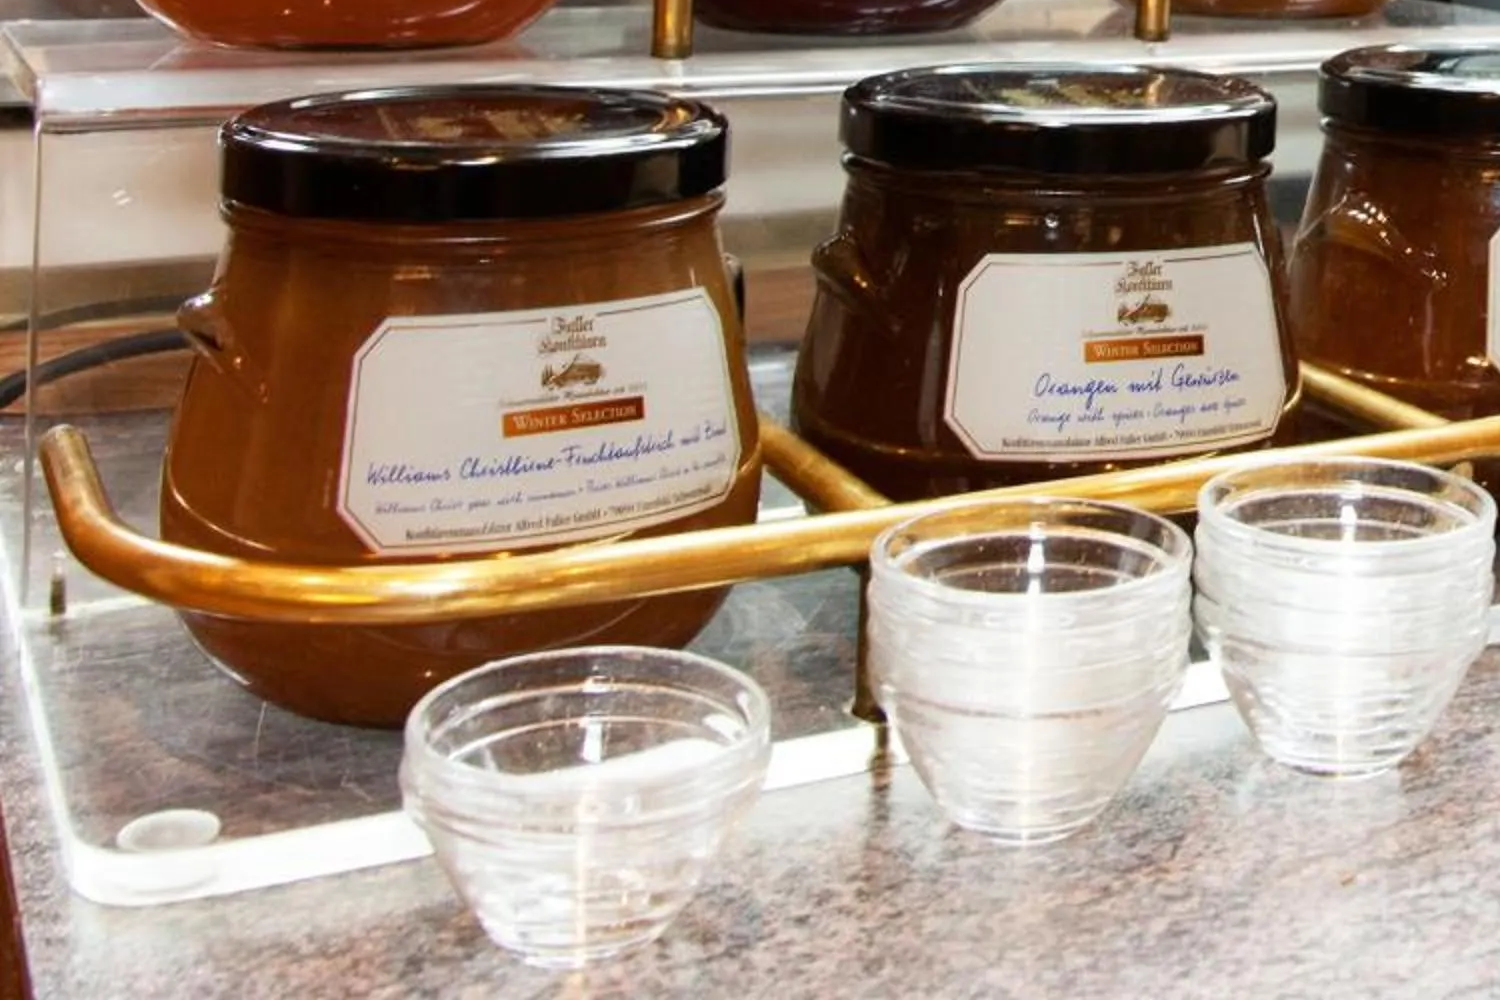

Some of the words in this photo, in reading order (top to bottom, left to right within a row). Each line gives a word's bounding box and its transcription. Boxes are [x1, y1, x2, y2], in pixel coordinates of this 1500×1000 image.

[1035, 372, 1118, 410] Orangen
[1127, 367, 1163, 393] mit
[513, 411, 567, 432] WINTER
[571, 403, 637, 425] SELECTION
[367, 462, 451, 485] Williams
